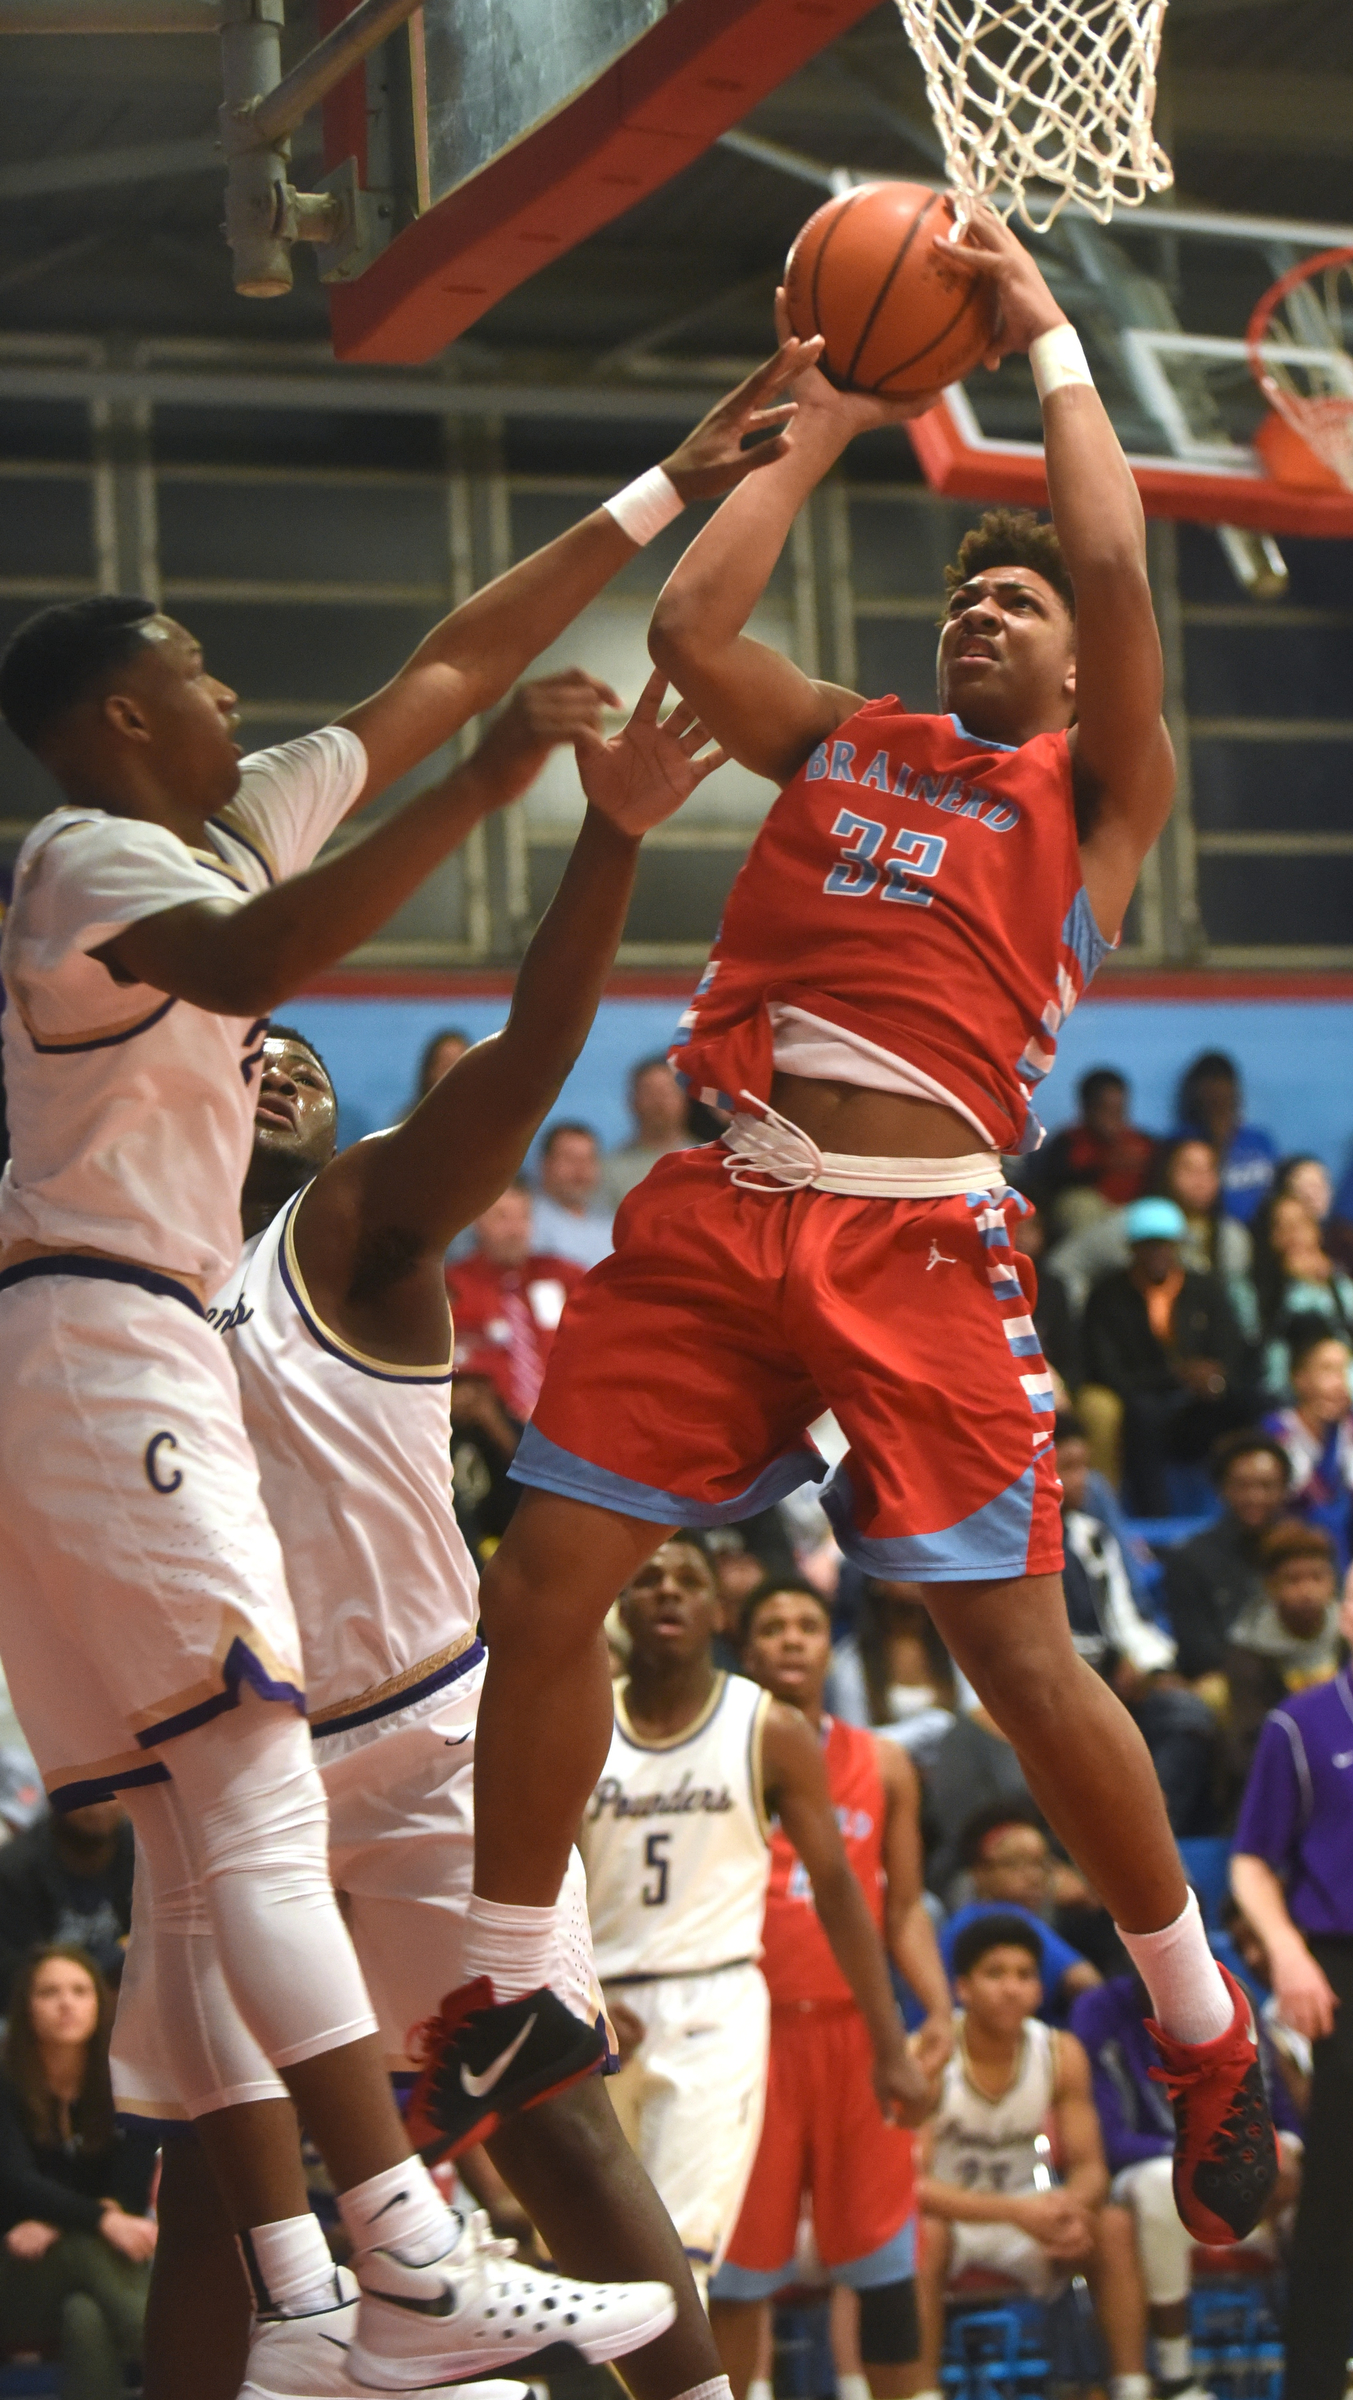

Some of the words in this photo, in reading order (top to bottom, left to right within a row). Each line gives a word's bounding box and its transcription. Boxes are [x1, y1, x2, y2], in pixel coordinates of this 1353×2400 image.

[805, 740, 1020, 832] BRAINERD
[823, 808, 947, 907] 32
[145, 1431, 183, 1494] C
[590, 1770, 733, 1820] Pounders
[642, 1832, 670, 1906] 5
